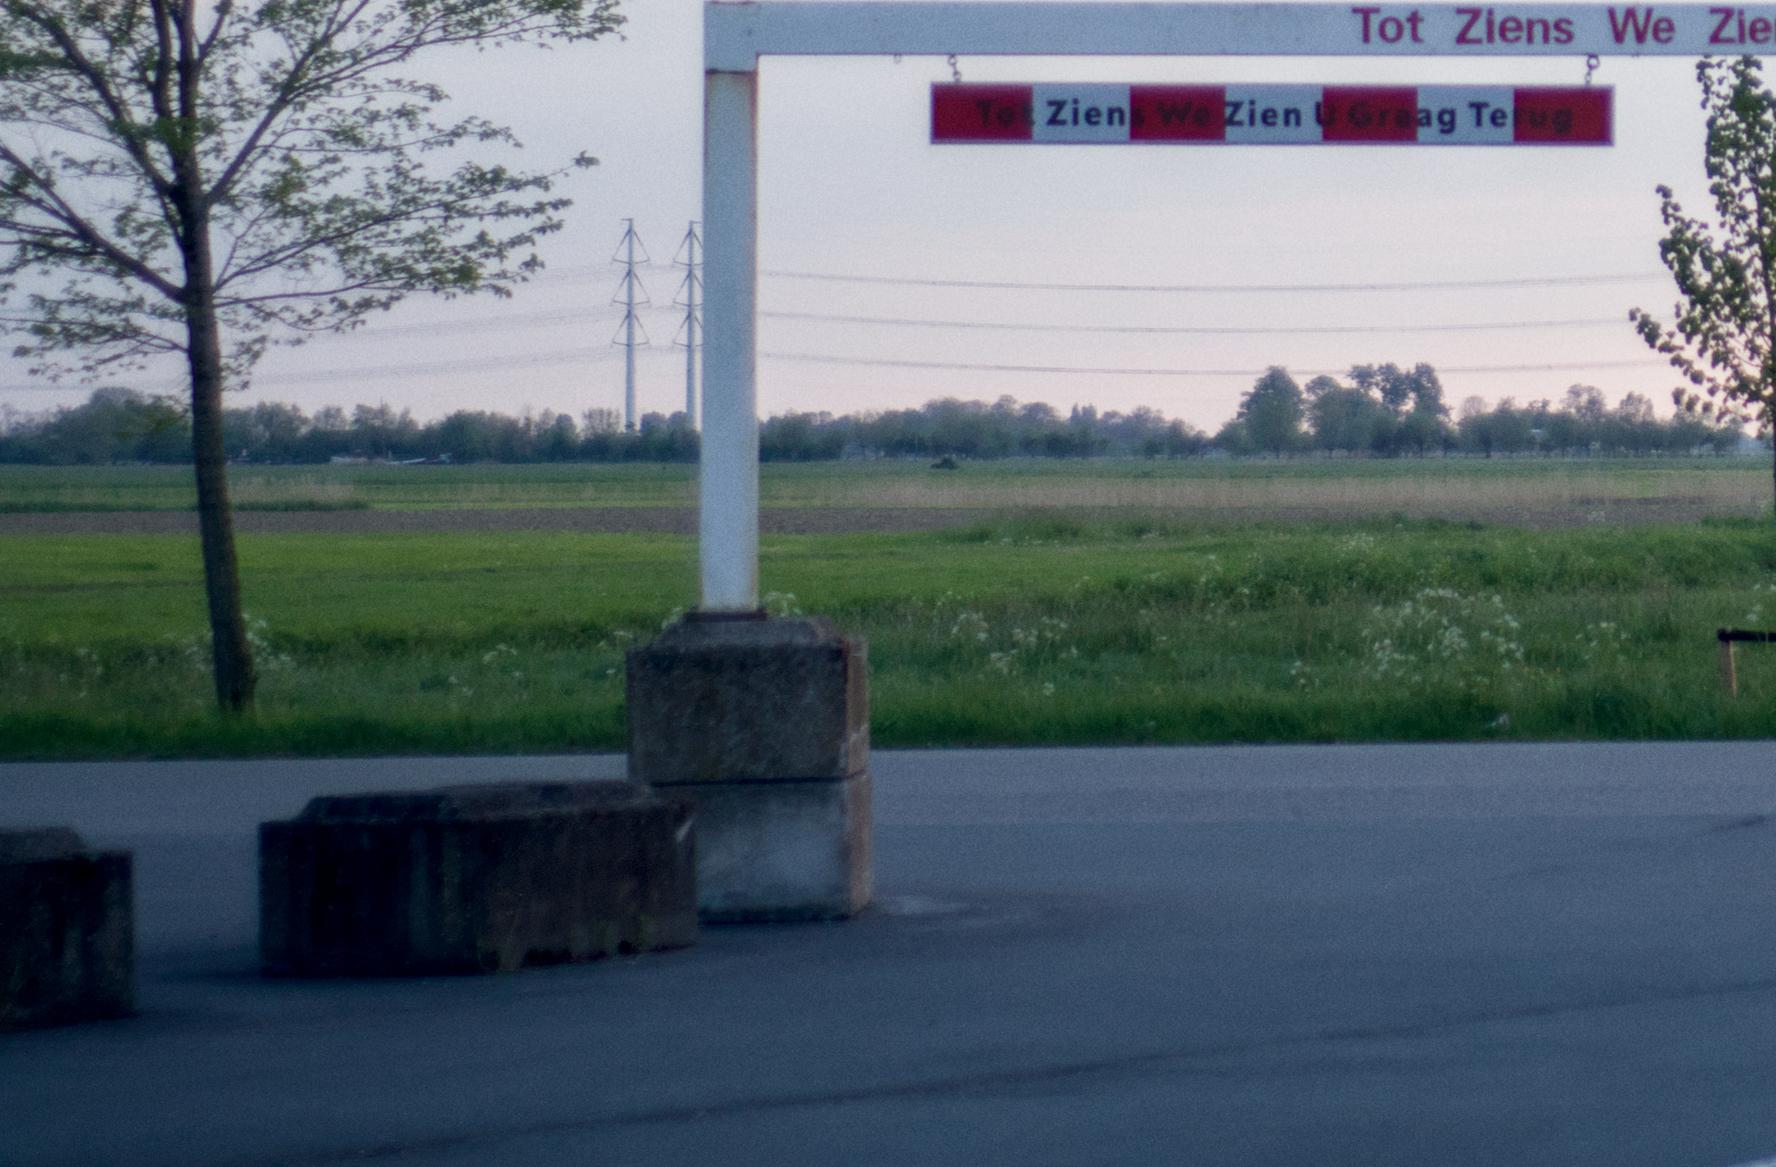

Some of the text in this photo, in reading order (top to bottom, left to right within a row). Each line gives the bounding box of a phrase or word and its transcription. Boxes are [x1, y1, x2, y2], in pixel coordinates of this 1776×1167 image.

[1352, 6, 1424, 44] Tot
[1455, 6, 1575, 45] Ziens
[1607, 6, 1676, 45] We
[976, 98, 1574, 134] Tot Ziens We Zien U Graag Terug
